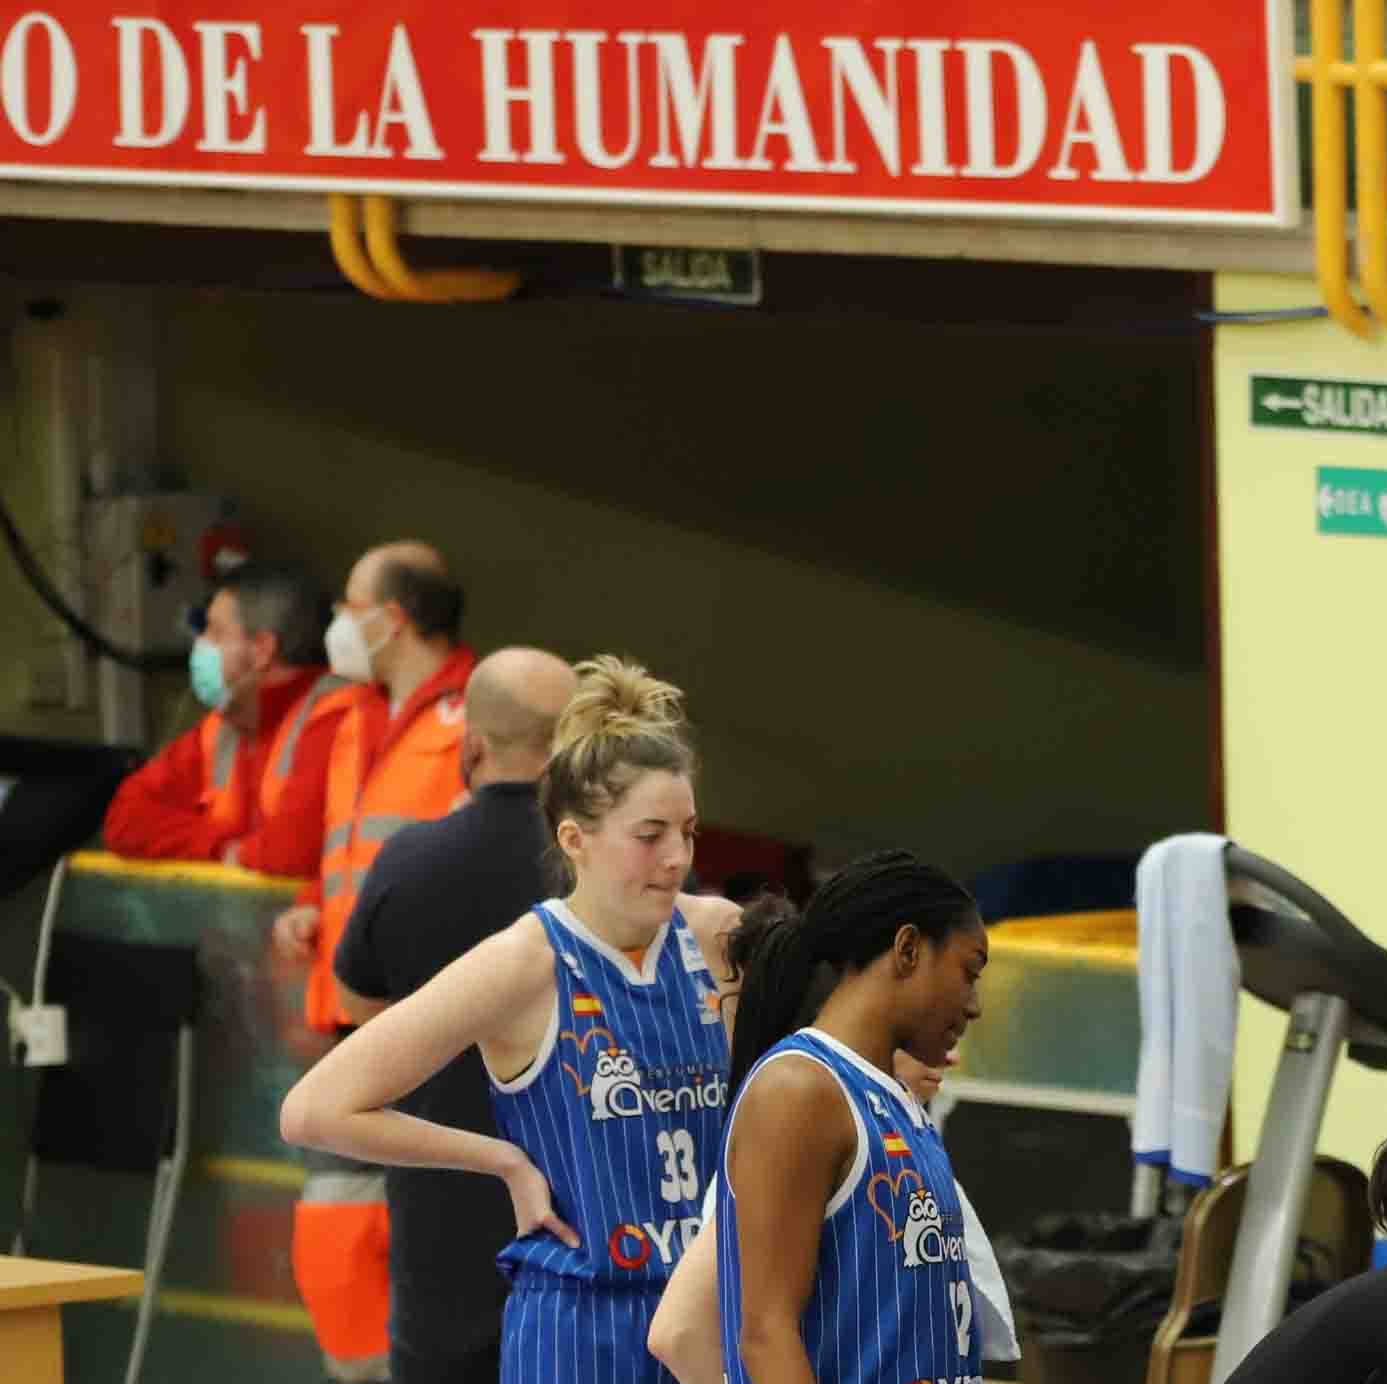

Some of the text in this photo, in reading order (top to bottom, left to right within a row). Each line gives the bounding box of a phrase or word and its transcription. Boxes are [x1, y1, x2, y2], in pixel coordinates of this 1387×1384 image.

[112, 16, 267, 155] DE
[301, 24, 445, 162] LA
[473, 29, 1226, 184] HUMANIDAD
[656, 1128, 699, 1203] 33
